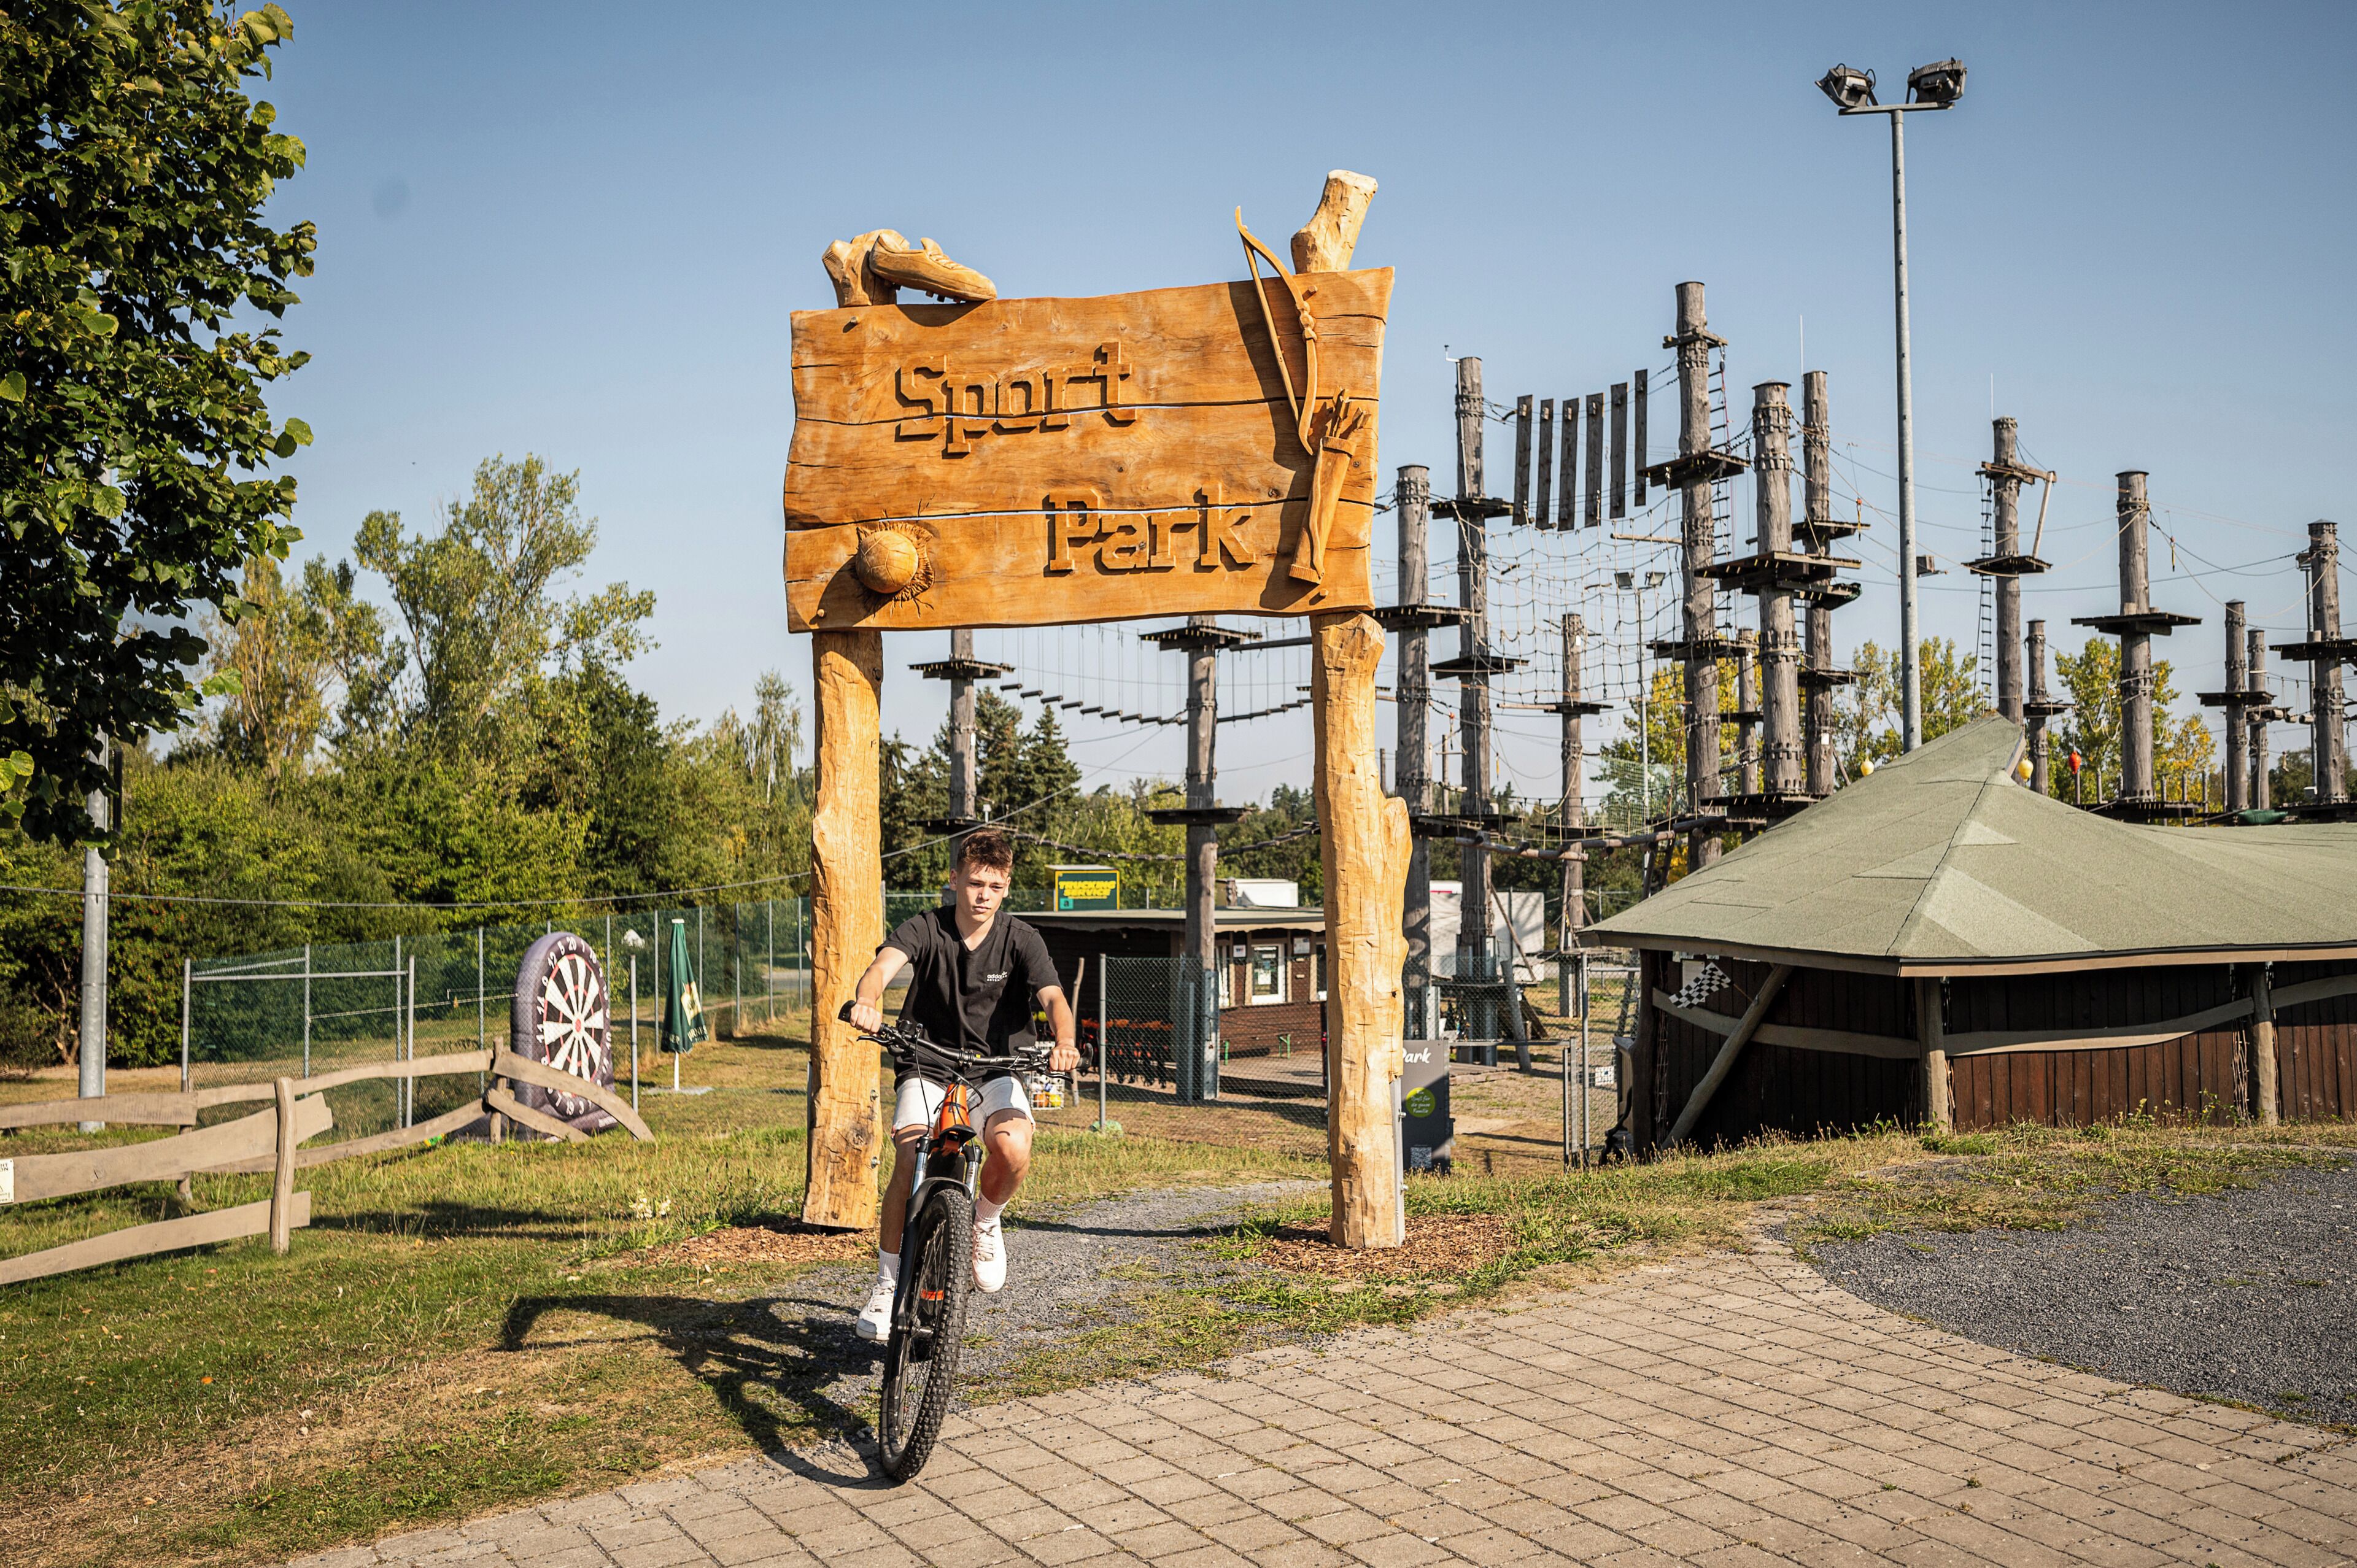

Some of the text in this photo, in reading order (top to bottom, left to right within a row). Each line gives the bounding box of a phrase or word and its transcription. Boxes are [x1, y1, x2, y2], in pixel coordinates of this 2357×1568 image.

[897, 341, 1138, 455] Sport
[1047, 484, 1256, 572] Park
[1058, 880, 1116, 889] TRUCKING
[557, 940, 565, 956] 5
[566, 936, 577, 951] 20
[547, 951, 557, 970] 12
